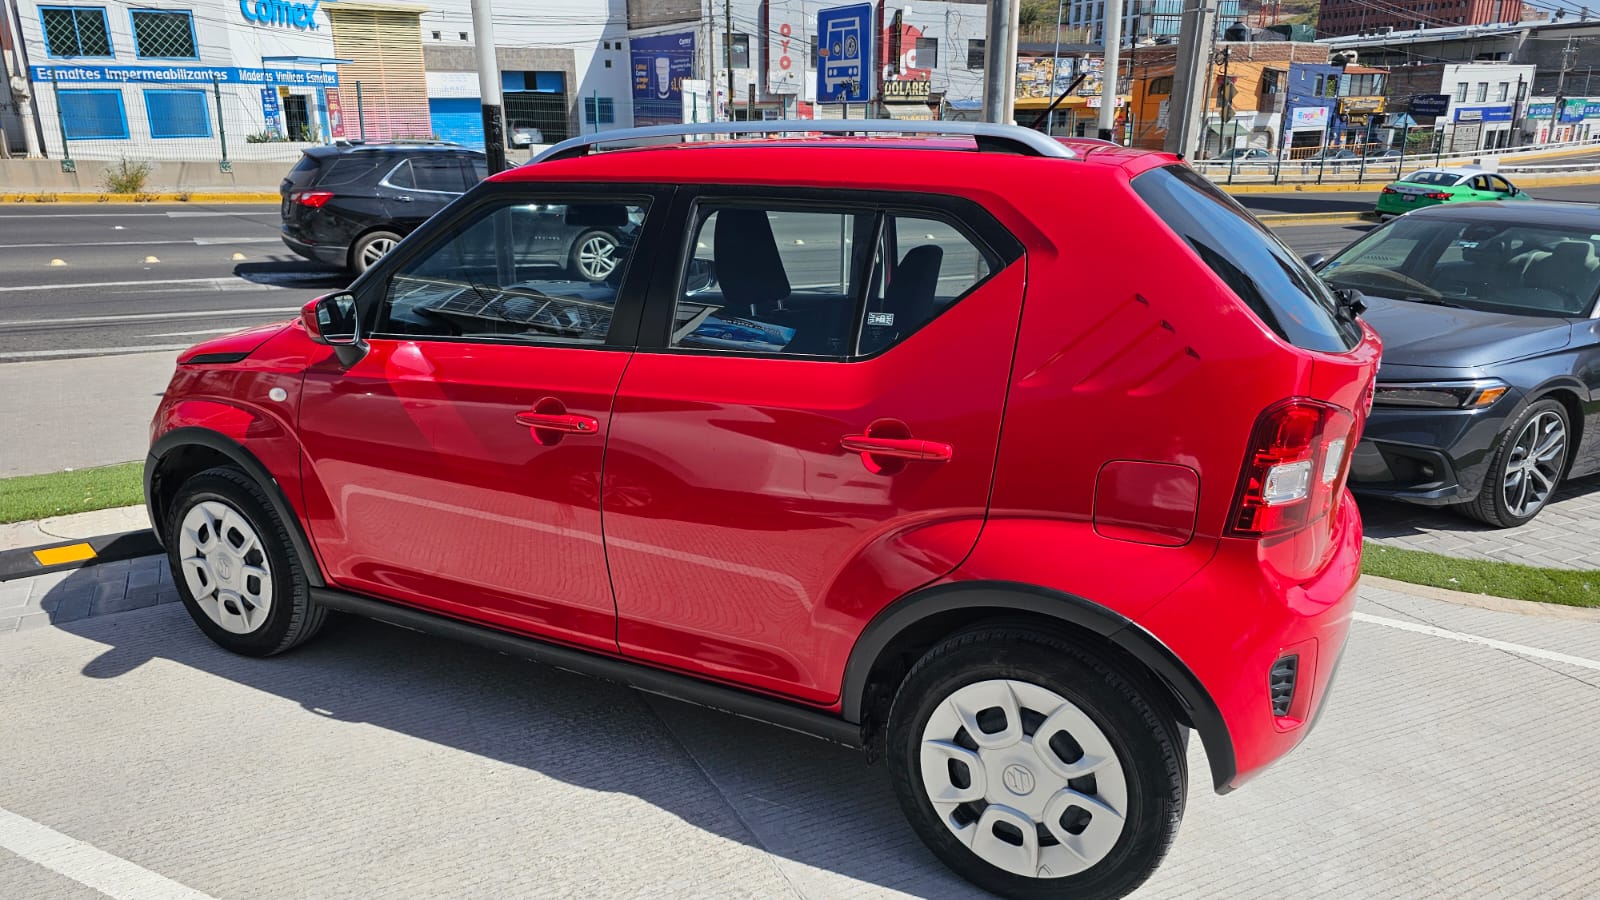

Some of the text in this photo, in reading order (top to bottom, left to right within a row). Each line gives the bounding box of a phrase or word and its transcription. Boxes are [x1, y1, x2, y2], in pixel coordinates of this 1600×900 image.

[239, 0, 319, 28] Comex
[779, 23, 792, 70] OYO
[35, 67, 228, 82] Esmaltes Impermeabilizantes
[238, 69, 273, 82] Maderas
[306, 73, 336, 84] Esmaltes
[884, 81, 930, 96] DOLARES
